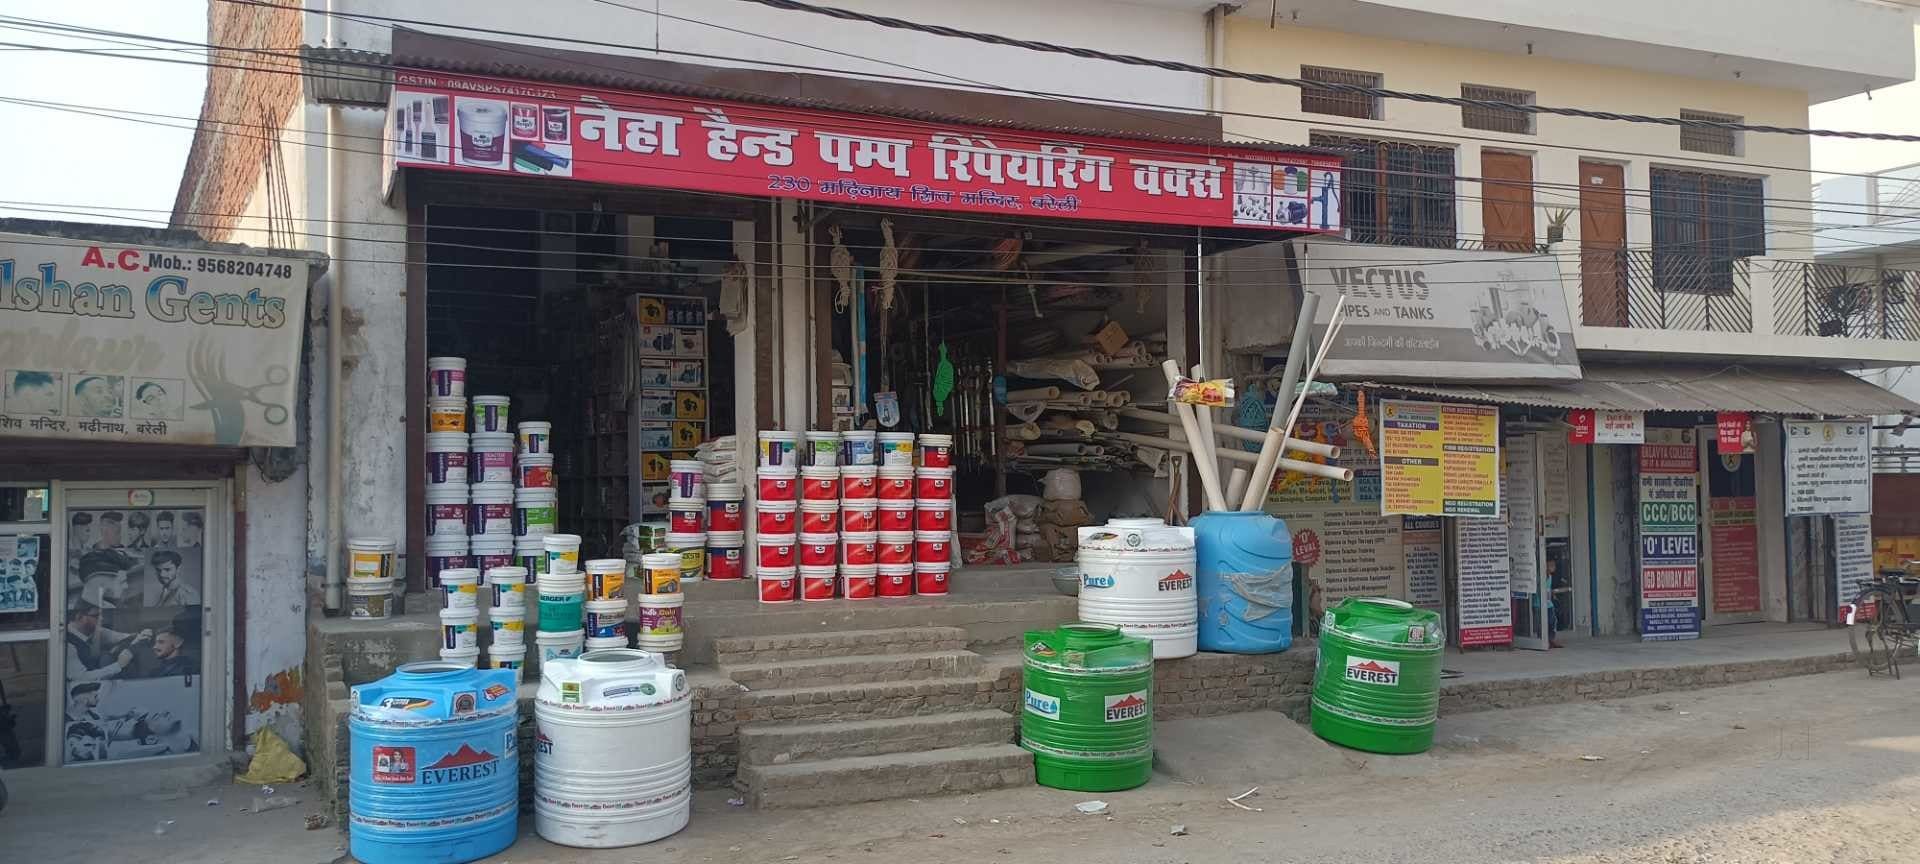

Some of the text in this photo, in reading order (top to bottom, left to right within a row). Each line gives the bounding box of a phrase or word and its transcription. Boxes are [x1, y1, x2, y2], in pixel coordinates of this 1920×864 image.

[693, 107, 800, 167] हैन्ड
[814, 131, 914, 178] पम्प
[928, 133, 1115, 191] रिपेयरिंग
[768, 175, 811, 192] 230
[910, 184, 956, 204] शिव
[1030, 194, 1080, 212] बरेली
[81, 246, 292, 279] A.C. Mob.: 9568204748
[1330, 265, 1430, 300] VECTUS
[145, 275, 286, 329] Gents
[1338, 304, 1434, 320] PIPES AND TANKS
[29, 416, 70, 433] मन्दिर,
[136, 421, 167, 435] बरेली
[1643, 503, 1695, 522] CCC/BCC
[1661, 535, 1695, 554] LEVEL
[1083, 574, 1106, 588] Pure
[1158, 576, 1193, 591] EVEREST
[1347, 668, 1398, 684] EVEREST
[1024, 690, 1050, 711] Pure
[1107, 702, 1147, 721] EVEREST
[422, 759, 500, 785] EVEREST
